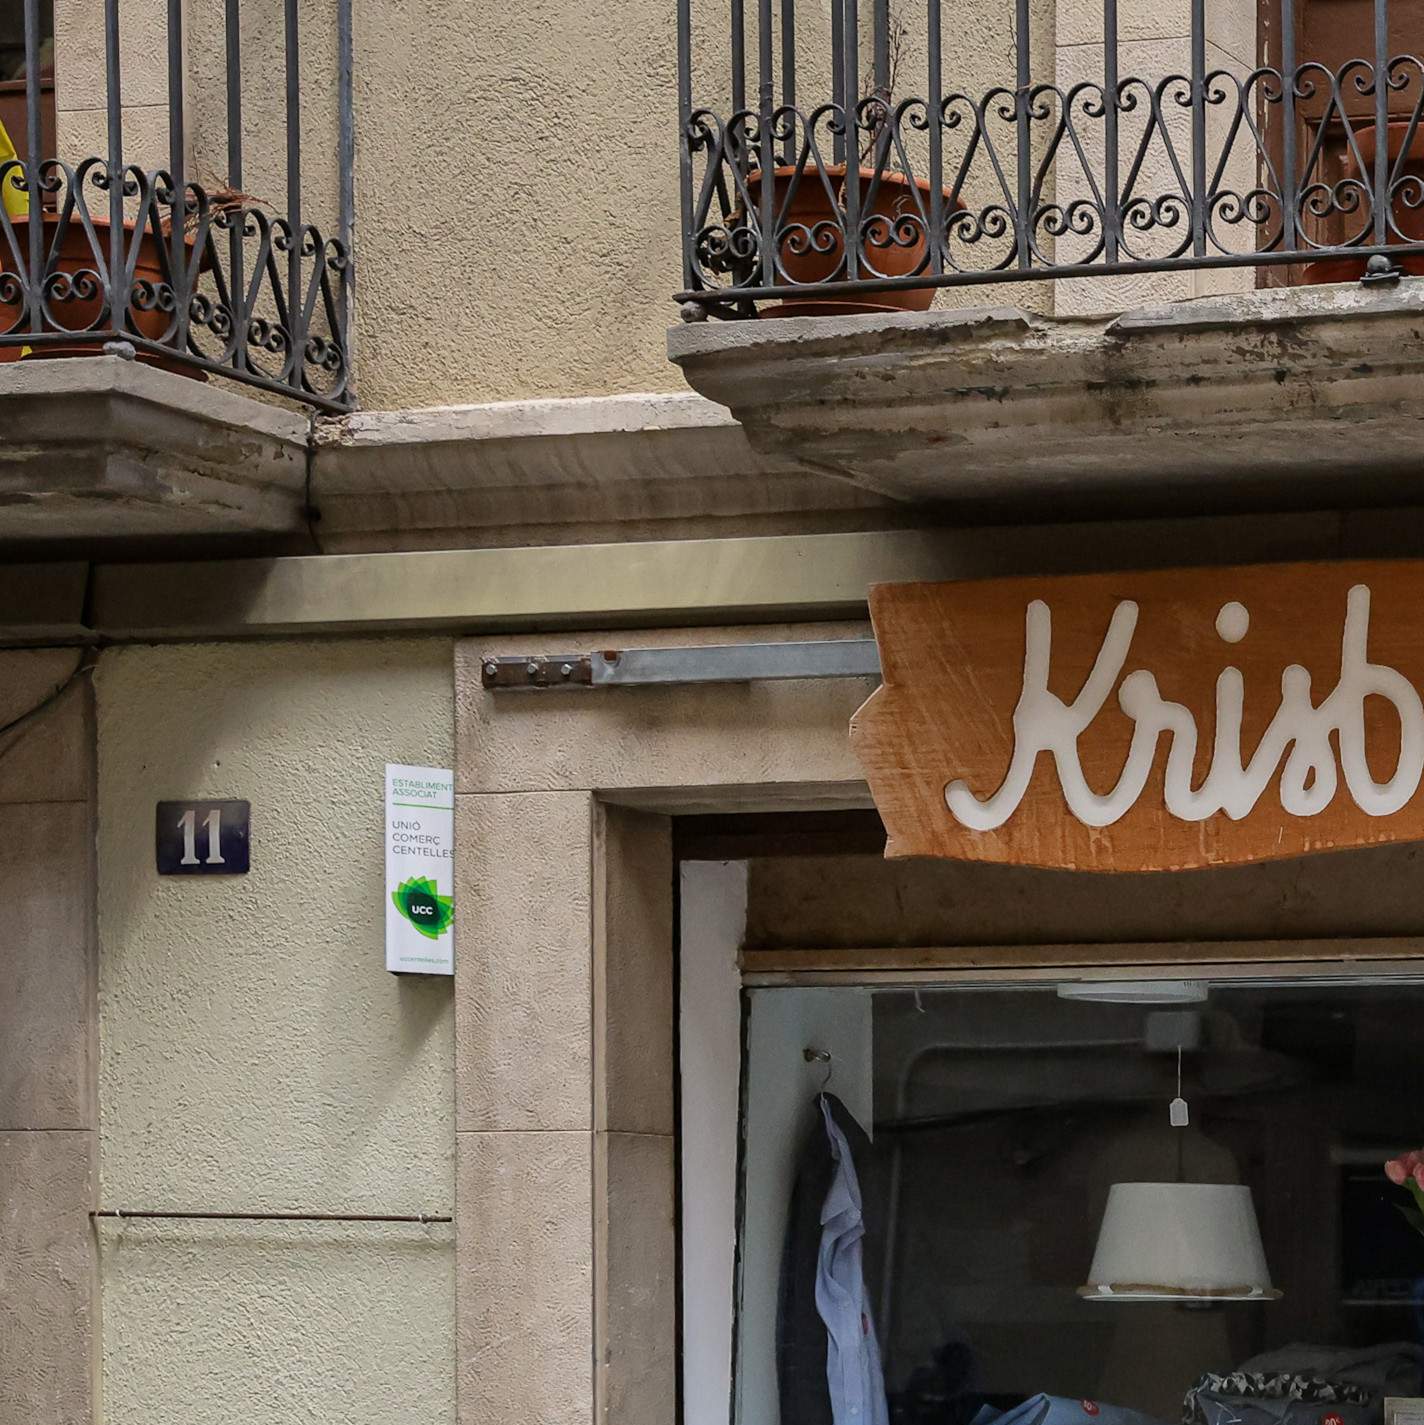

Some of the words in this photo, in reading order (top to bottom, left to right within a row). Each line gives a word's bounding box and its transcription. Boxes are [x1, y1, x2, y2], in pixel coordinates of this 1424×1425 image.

[392, 788, 437, 799] ASSOCIAT
[176, 809, 225, 865] 11
[392, 833, 440, 846] COMERÇ
[412, 905, 433, 915] UCC
